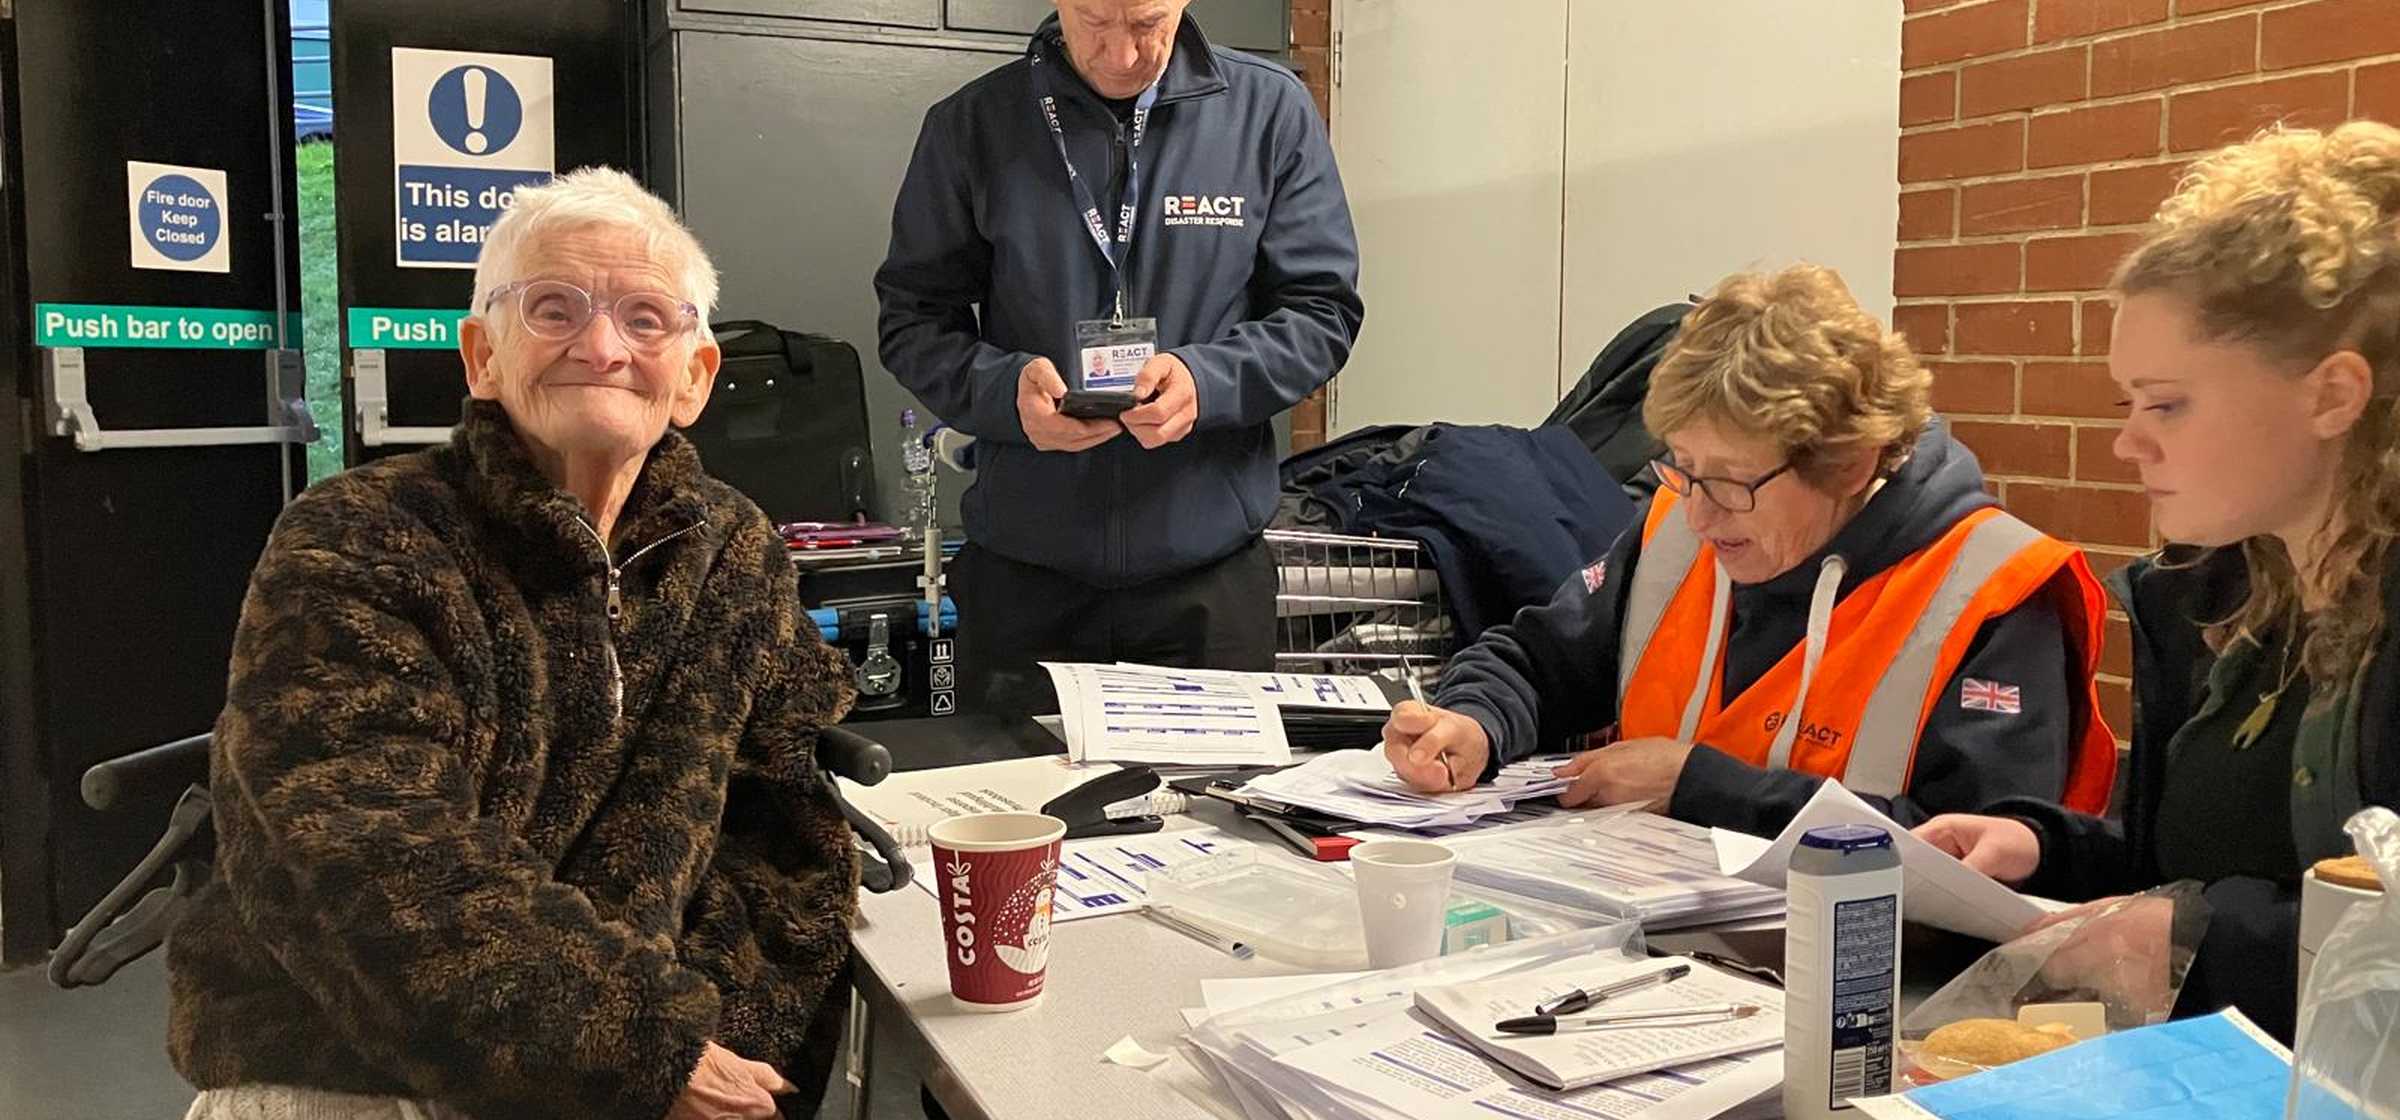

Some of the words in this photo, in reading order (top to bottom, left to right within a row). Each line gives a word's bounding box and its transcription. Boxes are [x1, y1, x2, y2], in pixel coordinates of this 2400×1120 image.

[1043, 96, 1062, 133] REACT
[146, 190, 174, 205] Fire
[178, 194, 210, 208] door
[405, 181, 470, 208] This
[479, 185, 513, 210] do
[1164, 195, 1245, 216] REACT
[162, 210, 197, 228] Keep
[401, 217, 426, 241] is
[435, 219, 490, 243] alar
[1087, 208, 1110, 242] REACT
[1117, 203, 1130, 242] REACT
[1165, 216, 1204, 226] DISASTER
[156, 228, 205, 244] Closed
[45, 312, 118, 338] Push
[127, 315, 170, 339] bar
[179, 317, 204, 339] to
[212, 322, 273, 346] open
[372, 316, 447, 341] Push
[1112, 347, 1147, 358] REACT
[952, 874, 976, 966] COSTA
